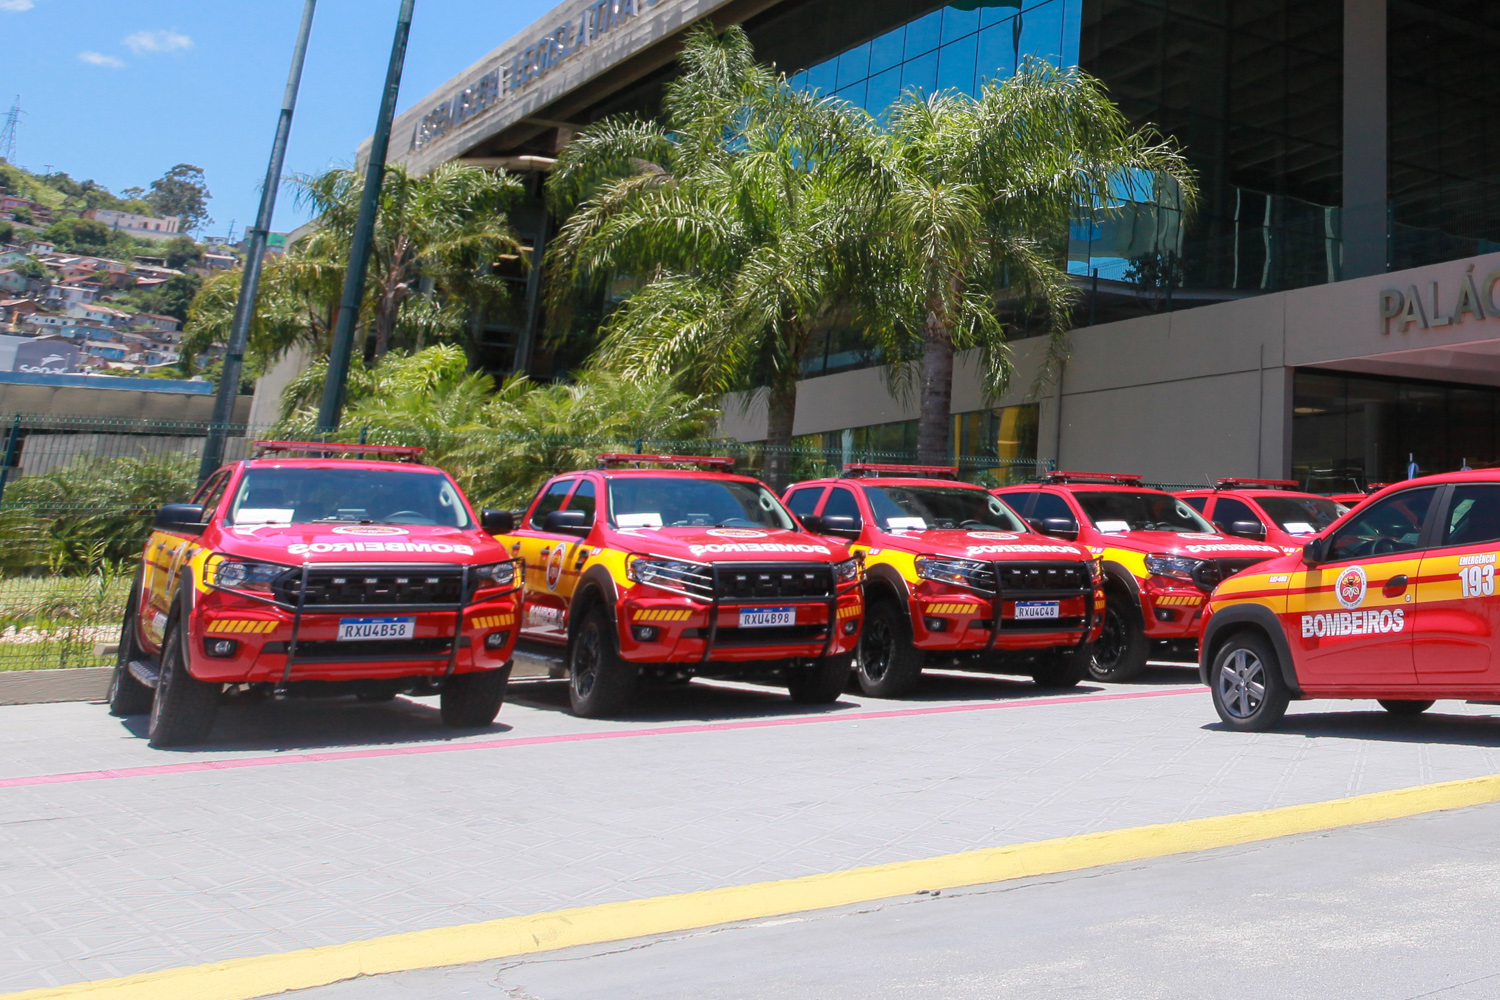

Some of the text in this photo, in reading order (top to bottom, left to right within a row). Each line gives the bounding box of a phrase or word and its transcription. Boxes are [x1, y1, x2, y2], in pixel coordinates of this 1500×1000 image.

[1458, 553, 1497, 566] EMERGÊNCIA
[1458, 564, 1496, 598] 193
[744, 612, 790, 626] RXU4B98
[1301, 608, 1405, 638] BOMBEIROS
[344, 623, 407, 638] RXU4B58
